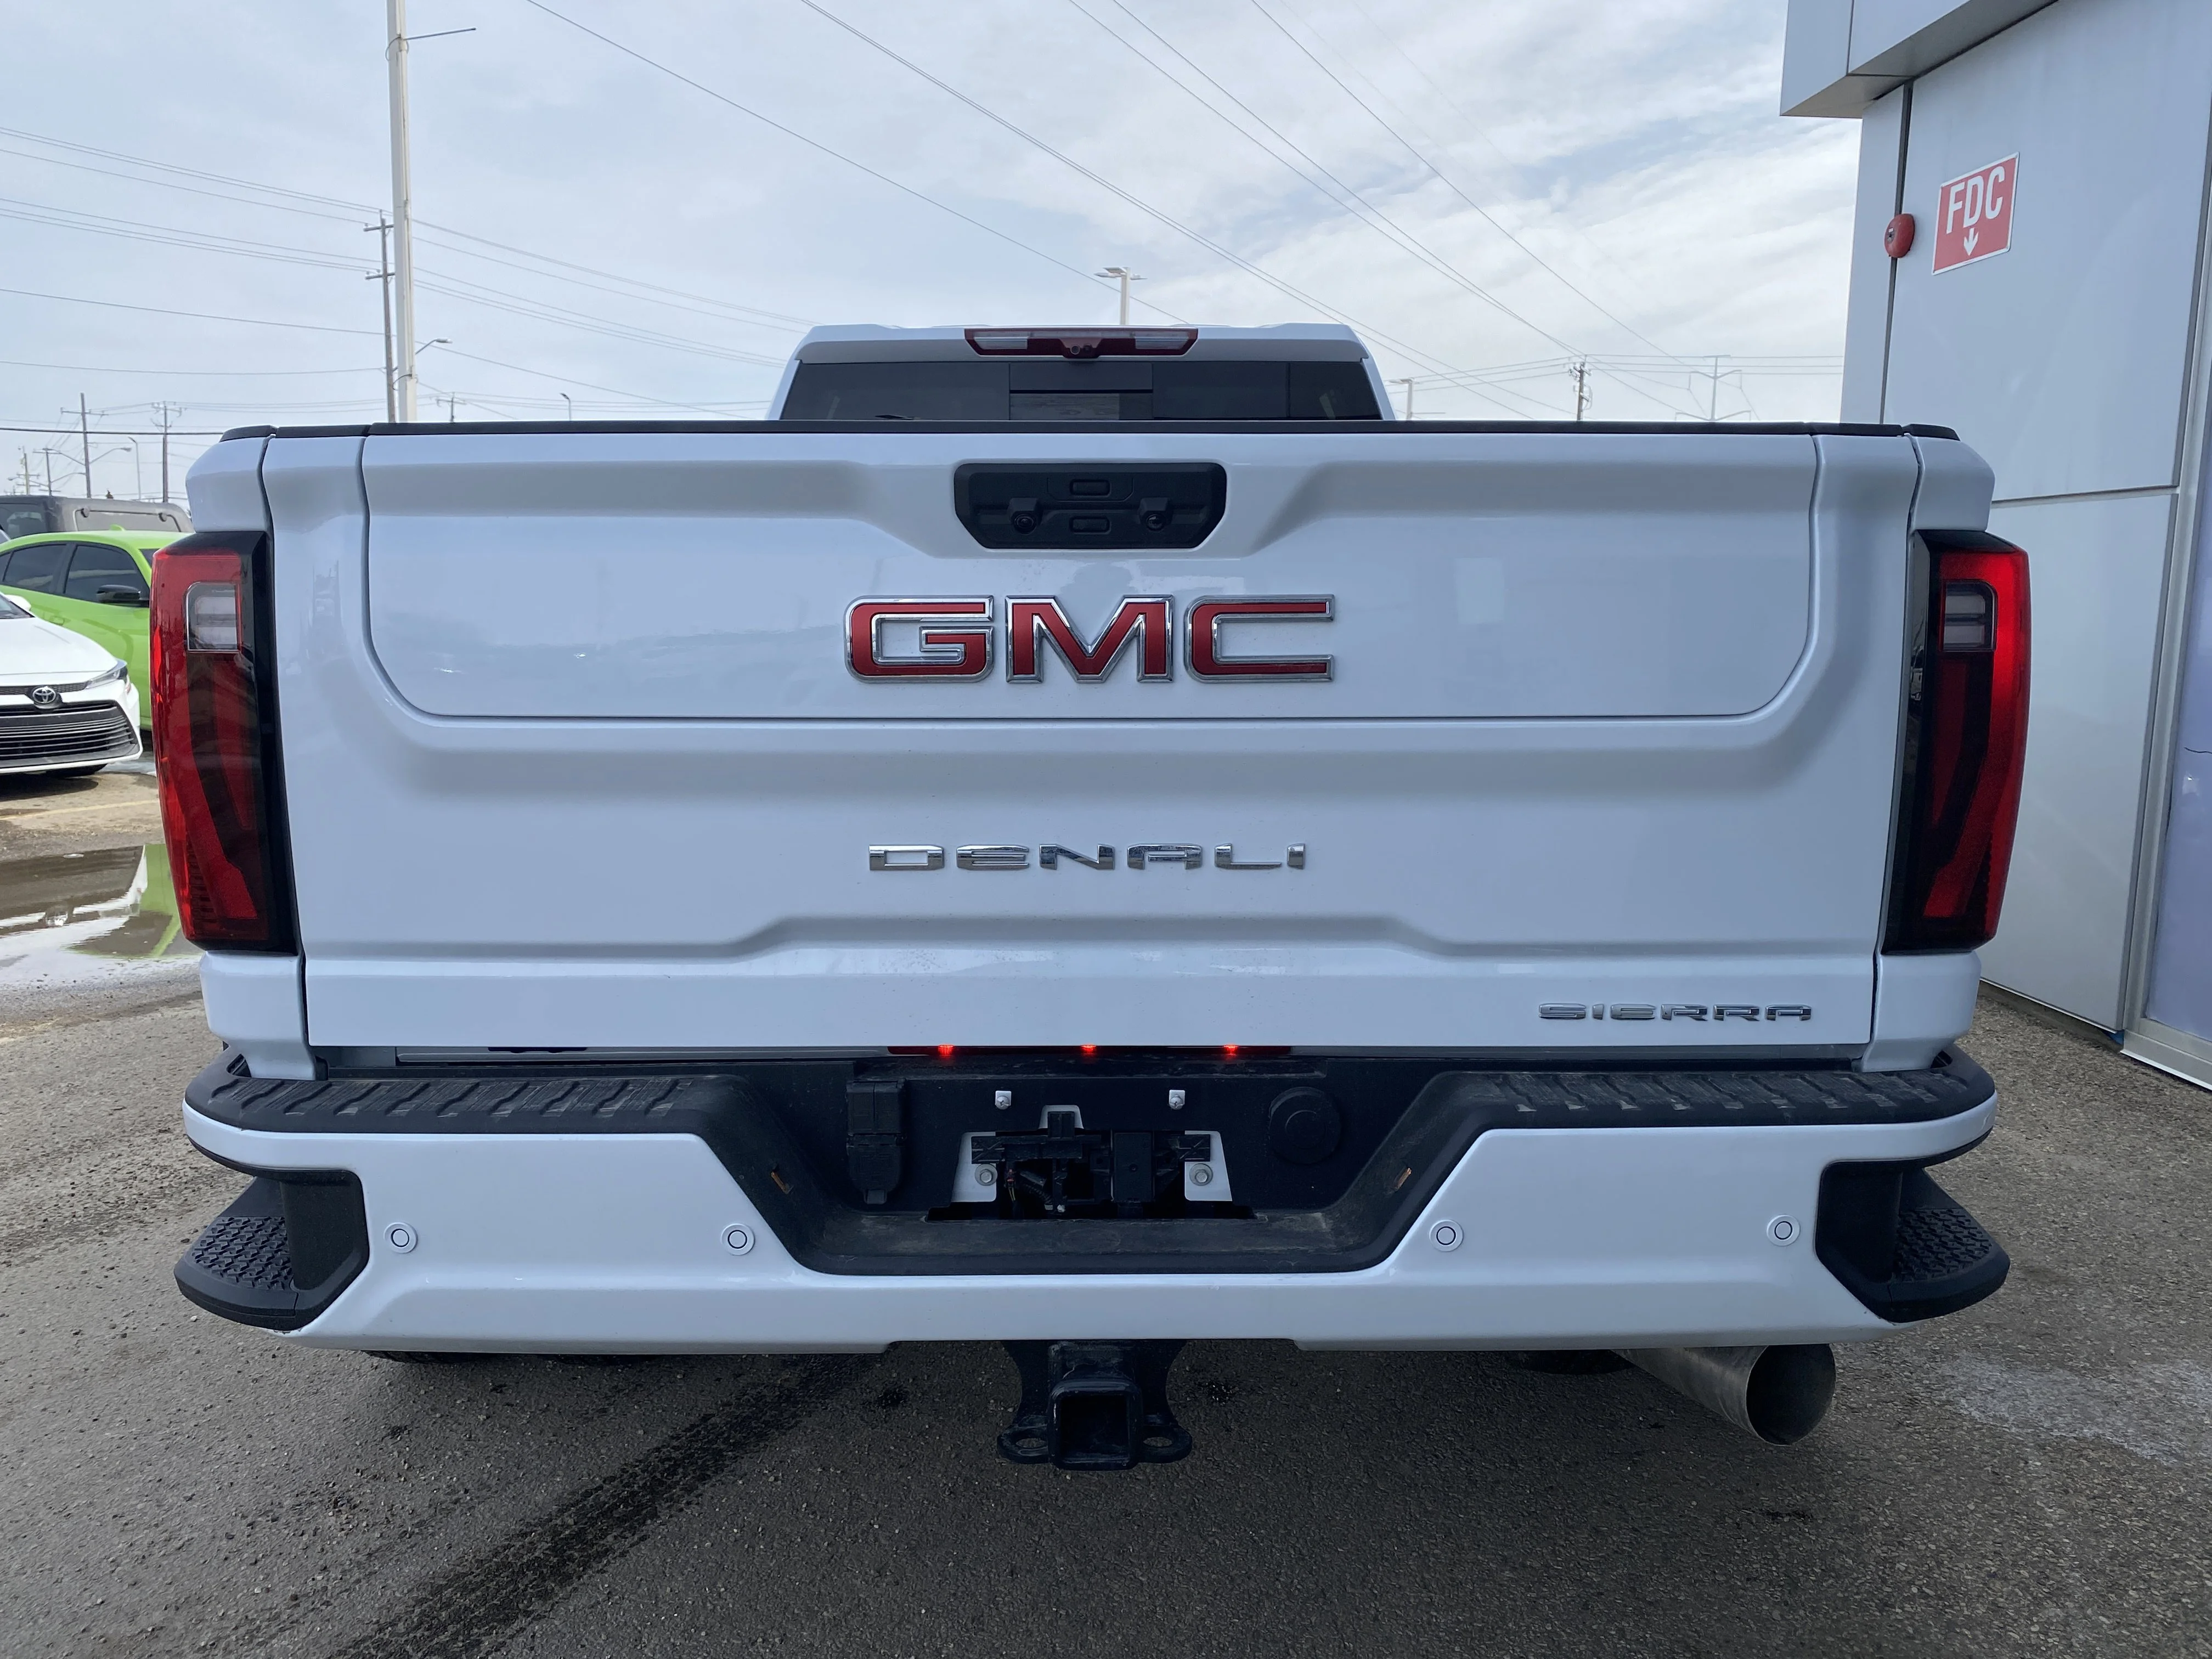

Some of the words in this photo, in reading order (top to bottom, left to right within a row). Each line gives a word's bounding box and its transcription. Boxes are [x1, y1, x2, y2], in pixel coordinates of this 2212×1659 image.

[1946, 166, 2005, 234] FDC
[844, 595, 1335, 683] GMC
[868, 843, 1306, 871] DENALI
[1538, 1003, 1813, 1021] SIERRA
